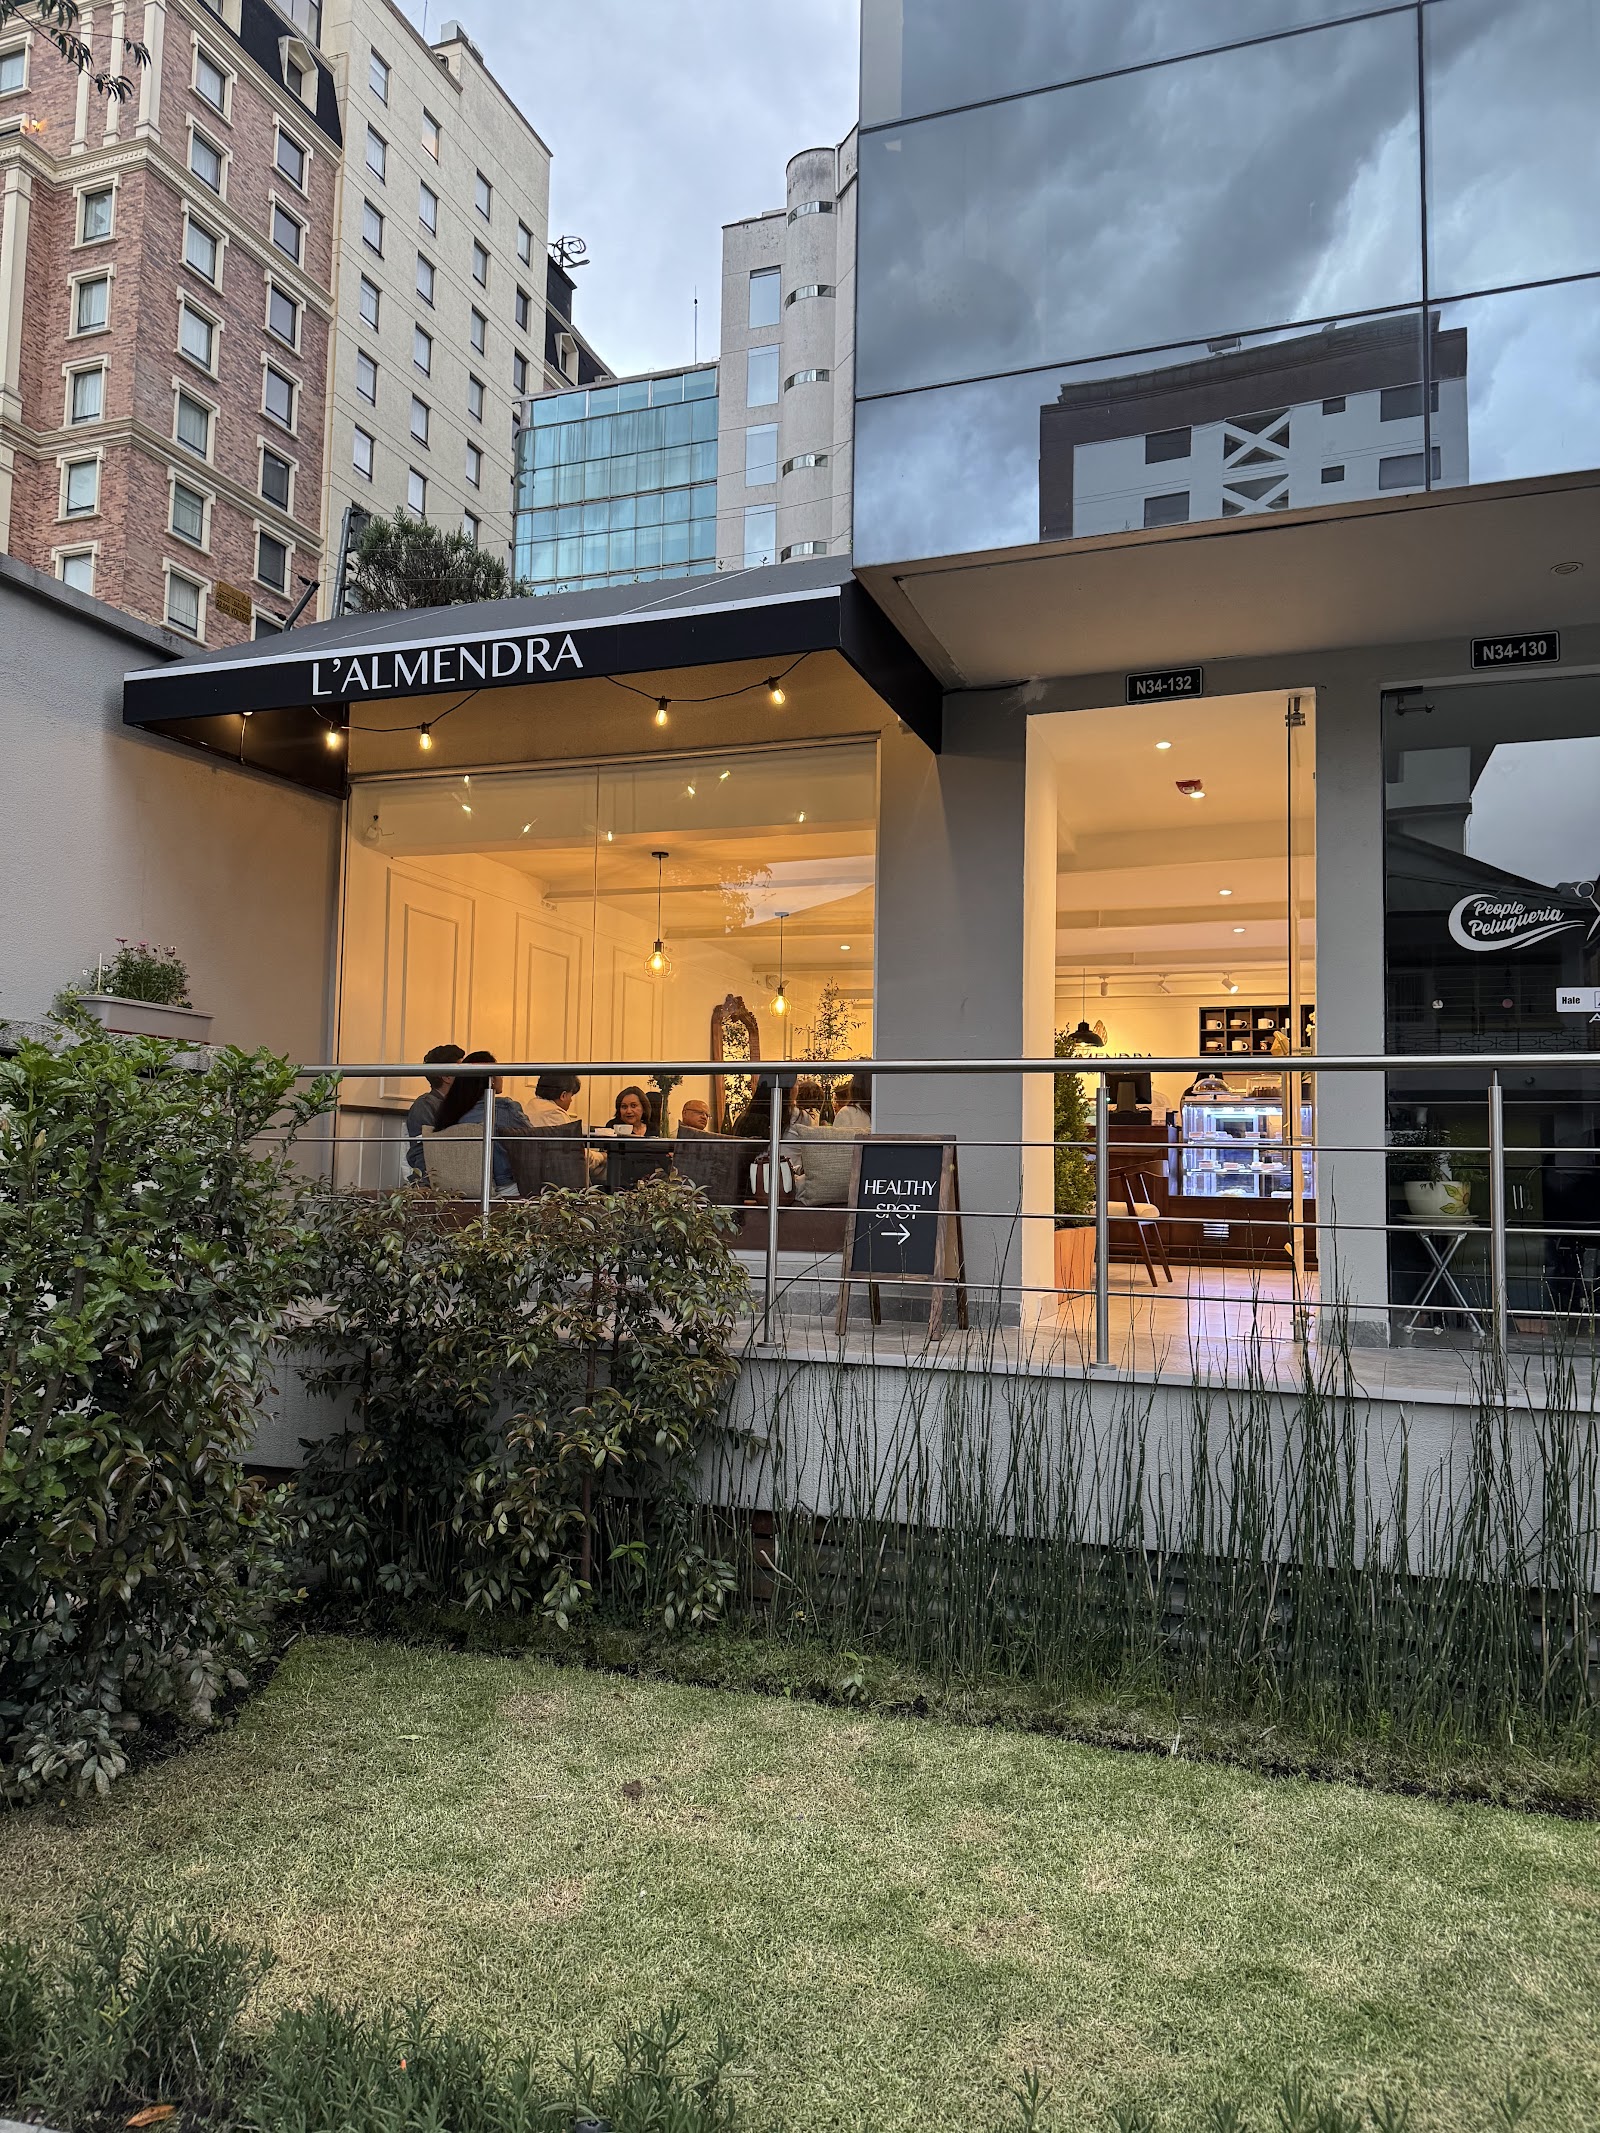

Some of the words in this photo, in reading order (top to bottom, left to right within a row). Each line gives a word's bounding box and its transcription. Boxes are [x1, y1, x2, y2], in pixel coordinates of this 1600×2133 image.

[1482, 640, 1547, 661] N34-130
[312, 633, 584, 696] L'ALMENDRA
[1136, 675, 1192, 695] N34-132
[1473, 900, 1527, 918] People
[1468, 905, 1565, 937] Peluqueria
[1561, 996, 1581, 1005] Hale
[864, 1179, 937, 1196] HEALTHY
[875, 1203, 921, 1220] SPOT
